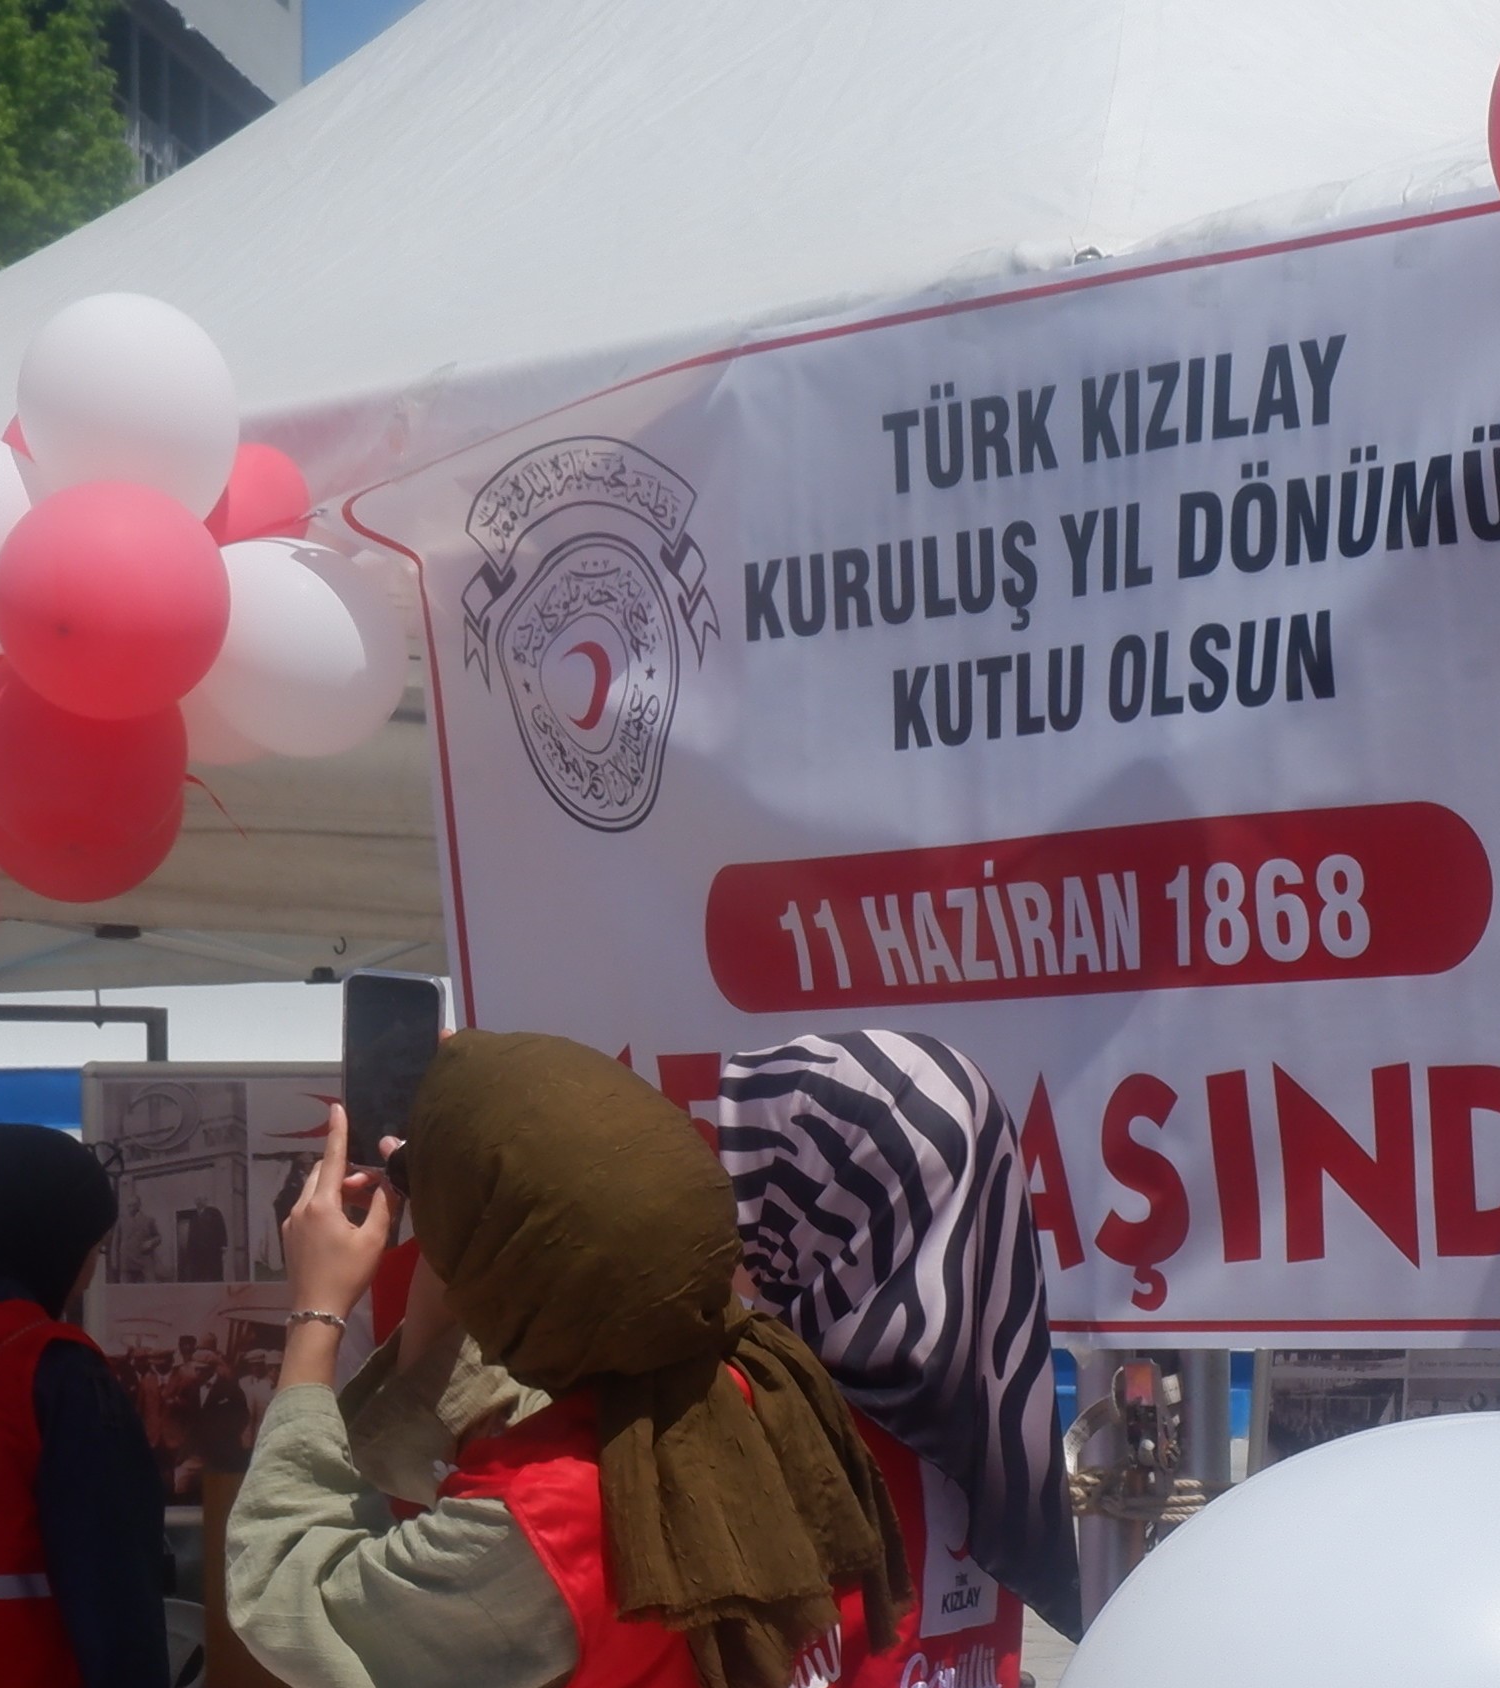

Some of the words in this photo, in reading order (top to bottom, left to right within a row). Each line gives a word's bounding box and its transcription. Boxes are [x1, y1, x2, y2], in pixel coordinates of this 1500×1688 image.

[883, 387, 1058, 496] TÜRK
[1080, 334, 1347, 462] KIZILAY
[743, 513, 1037, 641] KURULUŞ
[1064, 496, 1155, 597] YIL
[890, 642, 1086, 752] KUTLU
[1108, 610, 1336, 731] OLSUN
[781, 896, 852, 991] 11
[871, 859, 1140, 986] HAZİRAN
[1164, 854, 1371, 968] 1868
